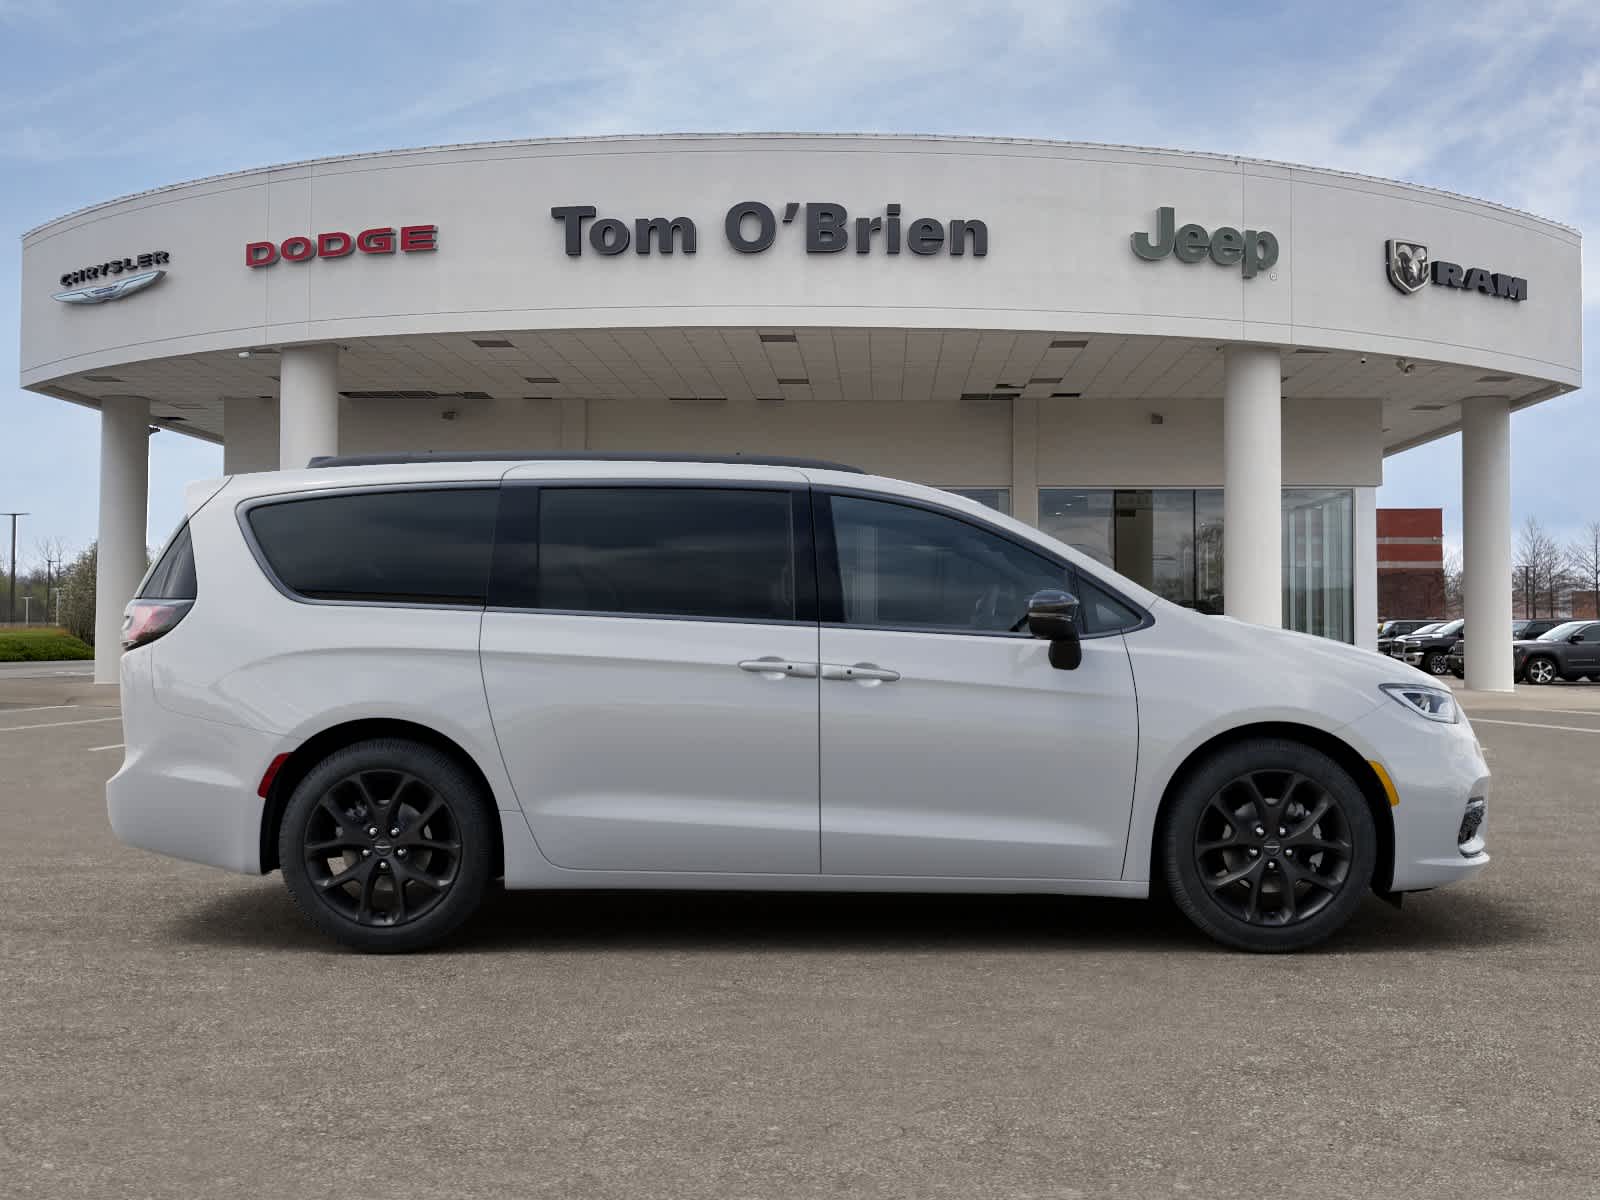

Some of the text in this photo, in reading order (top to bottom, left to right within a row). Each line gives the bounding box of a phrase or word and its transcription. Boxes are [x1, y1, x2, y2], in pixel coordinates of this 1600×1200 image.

[245, 225, 438, 269] DODGE
[551, 201, 988, 257] Tom O'Brien
[1130, 207, 1279, 279] Jeep
[59, 250, 170, 287] CHRYSLER
[1431, 261, 1527, 302] RAM
